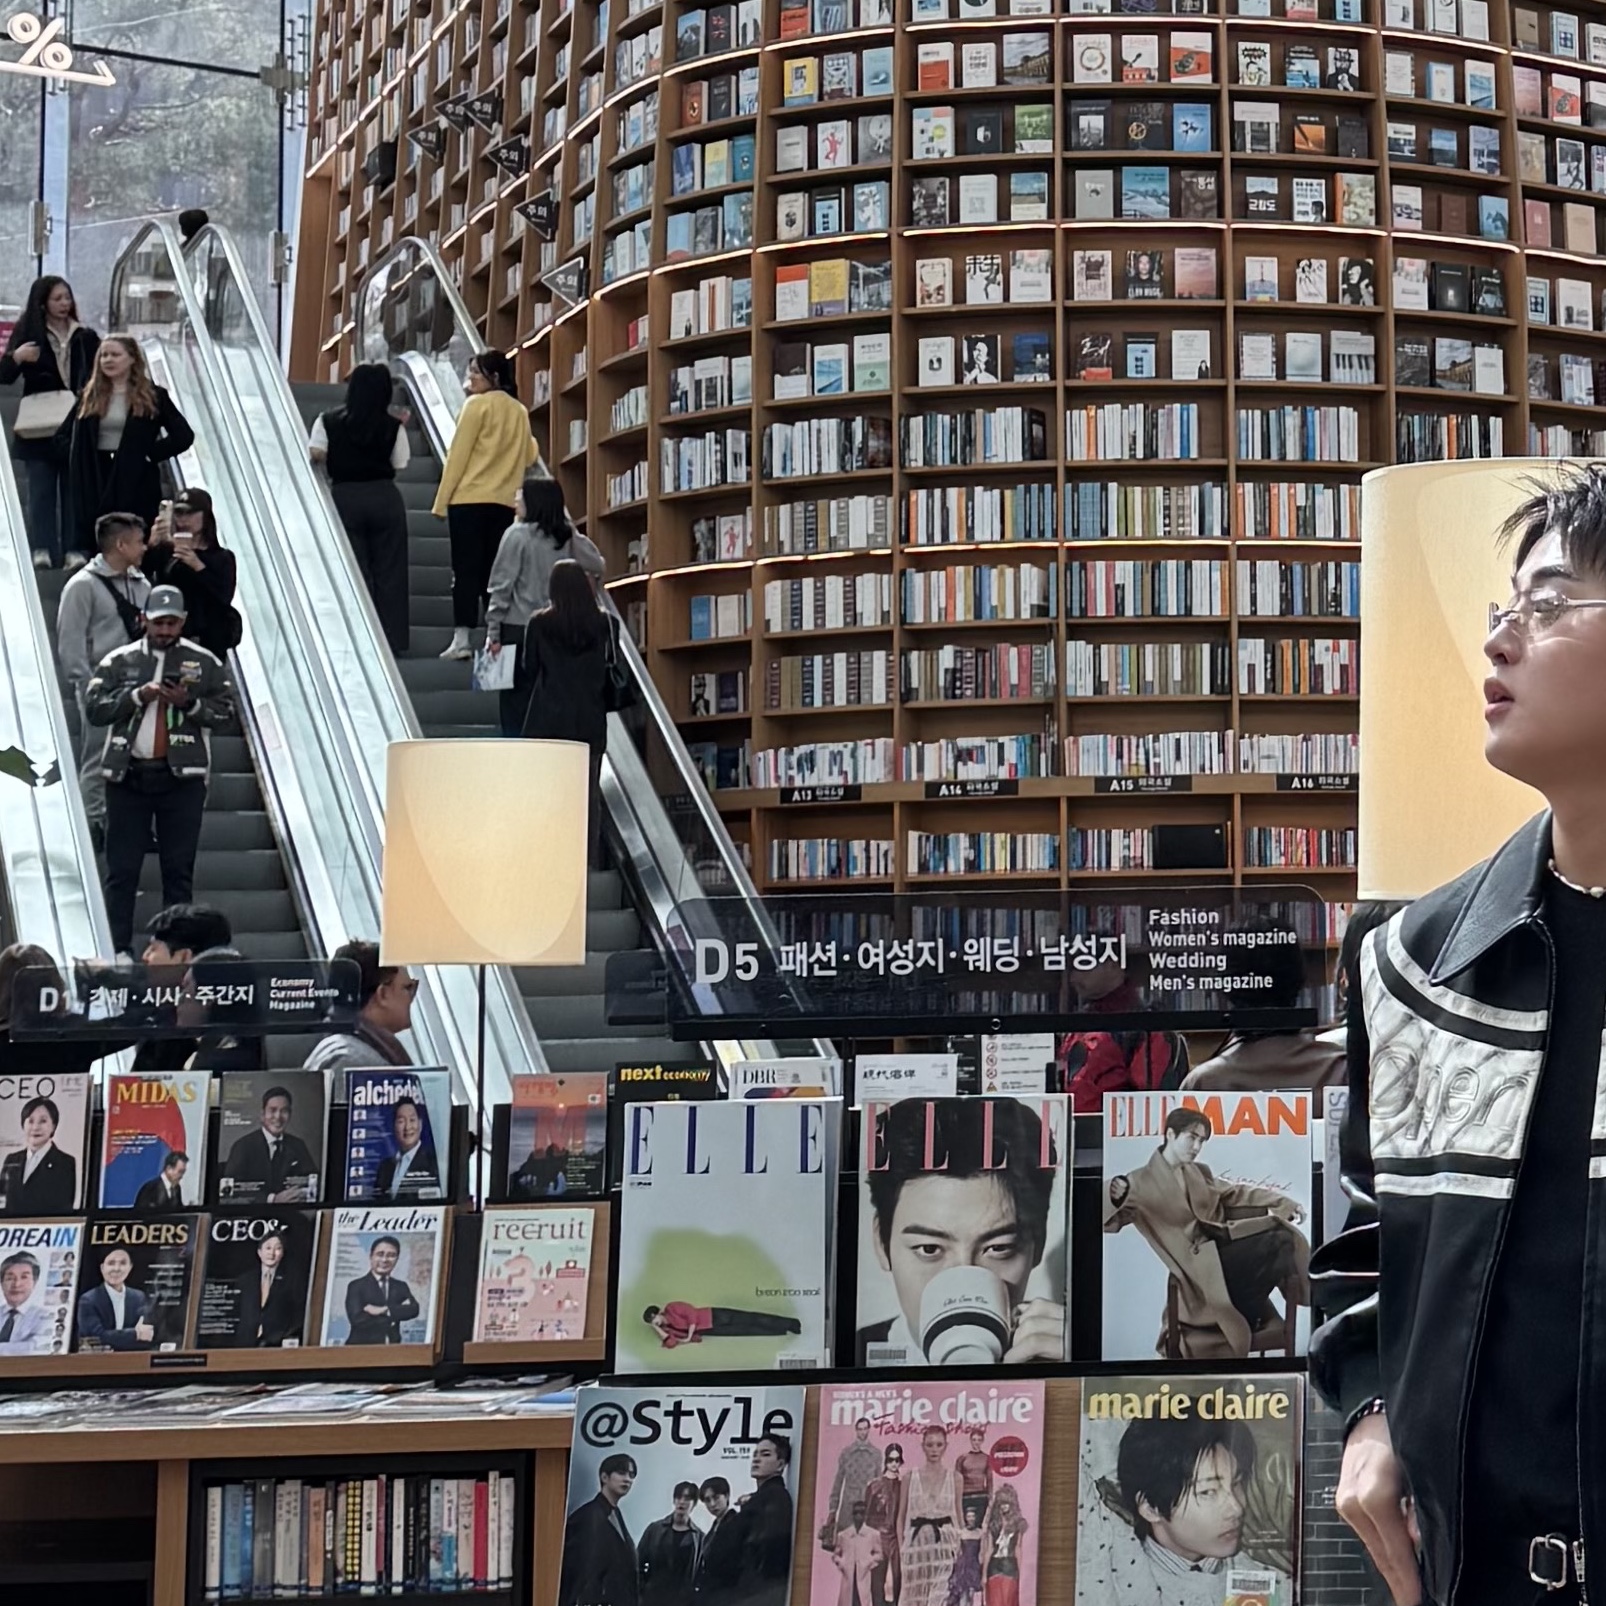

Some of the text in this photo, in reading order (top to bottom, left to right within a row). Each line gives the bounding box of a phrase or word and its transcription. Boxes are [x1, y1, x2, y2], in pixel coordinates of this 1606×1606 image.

[1110, 779, 1134, 792] A15
[1291, 776, 1315, 790] A16
[1149, 908, 1219, 926] Fashion
[1148, 928, 1297, 949] Women's magazine
[696, 938, 760, 984] D5
[1148, 951, 1227, 971] Wedding
[1149, 972, 1274, 993] Men's magazine
[619, 1066, 662, 1082] next
[0, 1076, 56, 1100] CEO
[117, 1081, 197, 1105] MIDAS
[630, 1105, 824, 1175] ELLE
[866, 1101, 1063, 1172] ELLE
[359, 1209, 439, 1231] Leader
[492, 1217, 587, 1241] recruit
[90, 1224, 190, 1245] LEADERS
[830, 1387, 1034, 1426] marie claire
[1088, 1383, 1290, 1421] marie claire
[580, 1396, 794, 1456] @Style
